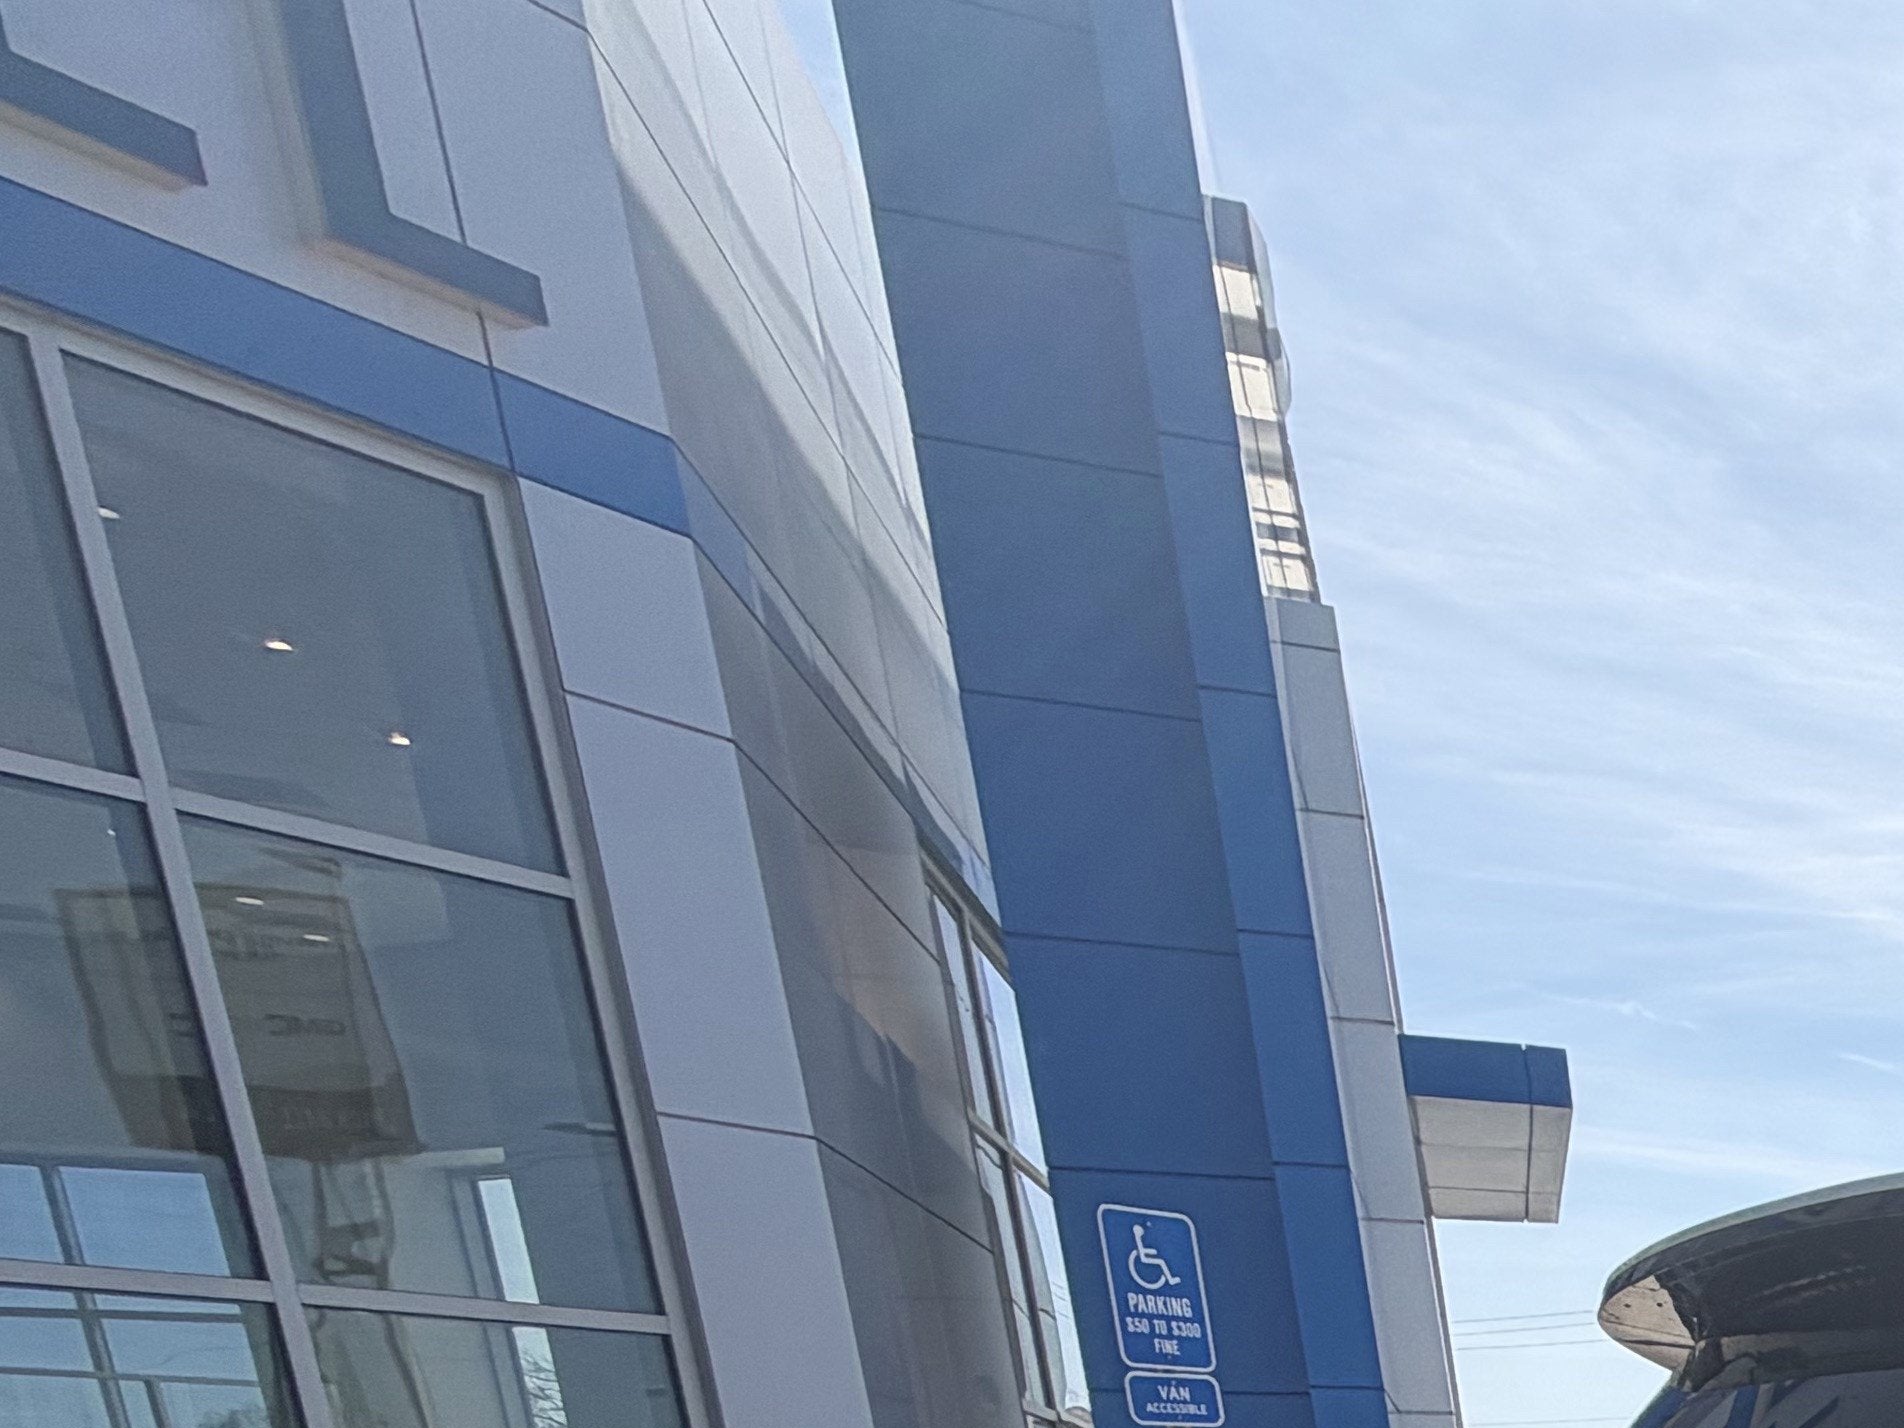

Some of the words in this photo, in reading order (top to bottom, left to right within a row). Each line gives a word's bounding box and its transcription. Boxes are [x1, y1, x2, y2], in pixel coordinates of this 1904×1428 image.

[1126, 1291, 1193, 1318] PARKING
[1125, 1316, 1150, 1334] $50
[1153, 1318, 1168, 1336] TO
[1170, 1320, 1202, 1339] $300
[1153, 1338, 1181, 1356] FINE
[1156, 1384, 1191, 1402] VAN
[1145, 1401, 1208, 1416] ACCESSIBLE
